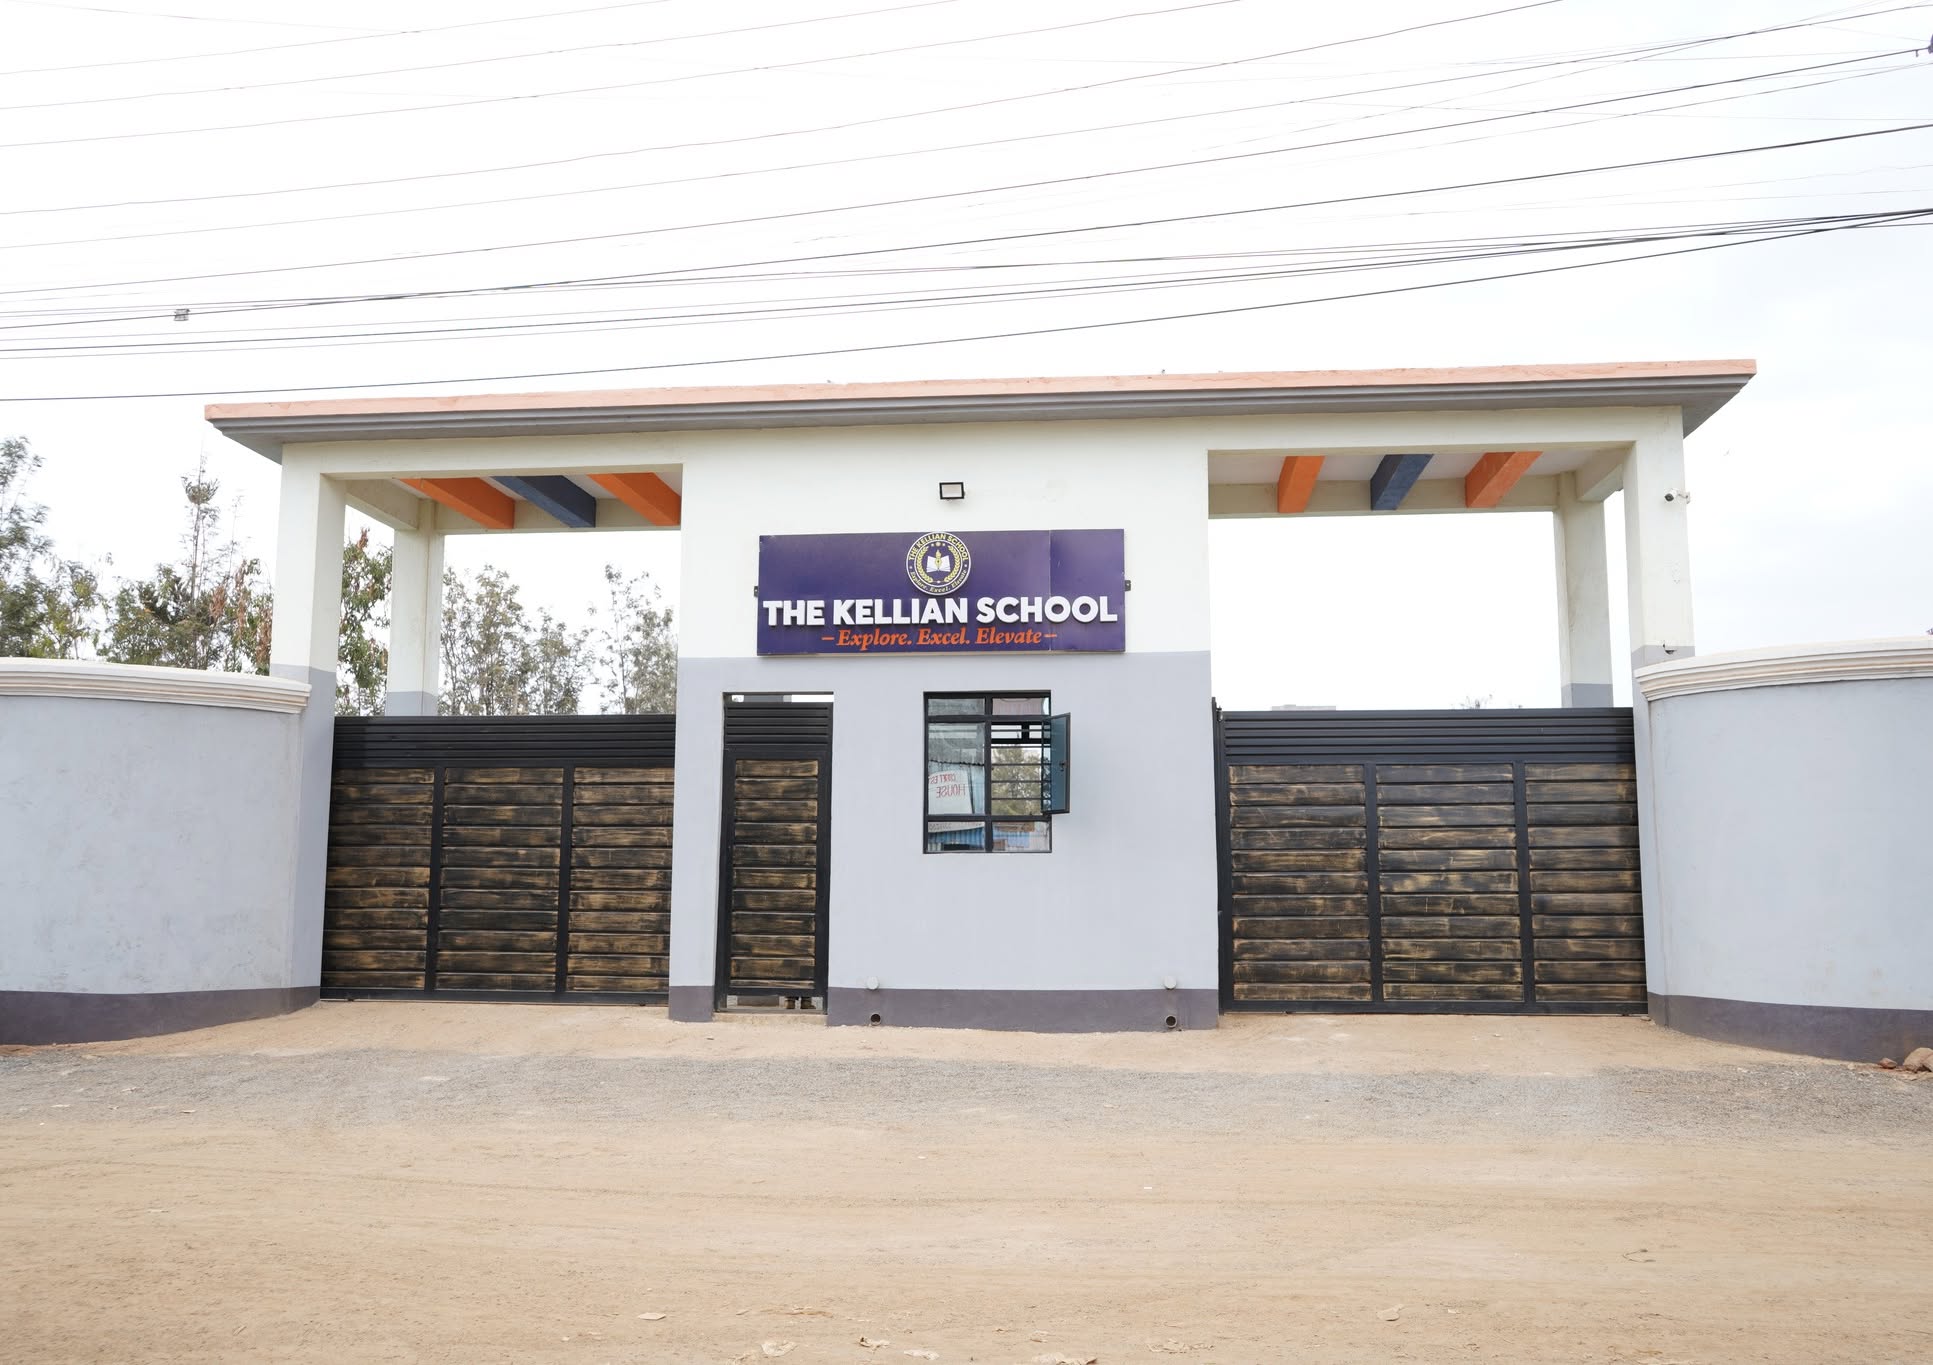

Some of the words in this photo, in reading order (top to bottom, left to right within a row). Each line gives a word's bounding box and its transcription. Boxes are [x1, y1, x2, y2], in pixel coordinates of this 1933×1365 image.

[909, 548, 918, 560] THE
[916, 534, 946, 547] KELLIAN
[948, 536, 969, 560] SCHOOL
[763, 600, 825, 626] THE
[833, 598, 968, 625] KELLIAN
[976, 596, 1118, 623] SCHOOL
[916, 627, 970, 645] Excel.
